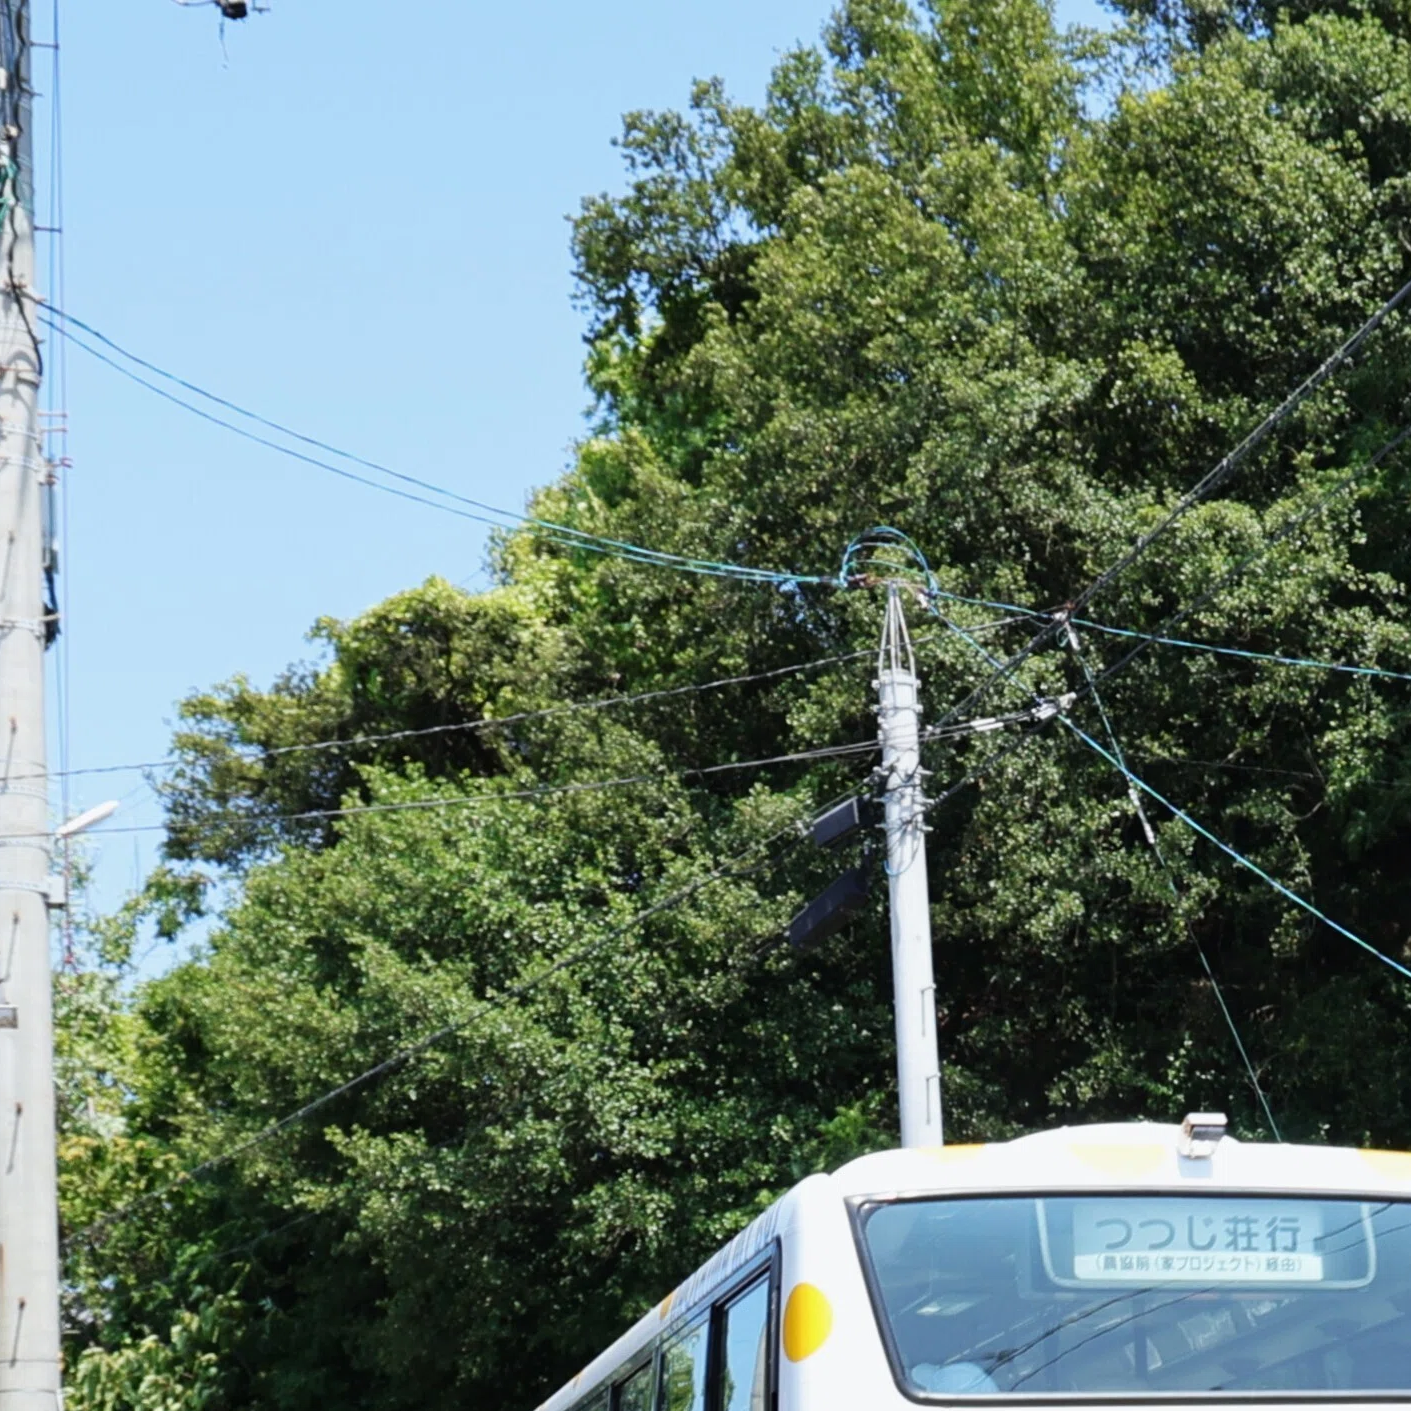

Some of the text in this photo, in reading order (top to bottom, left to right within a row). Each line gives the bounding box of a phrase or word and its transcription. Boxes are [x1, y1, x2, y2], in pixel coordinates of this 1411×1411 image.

[1095, 1215, 1301, 1252] つつじ荘行
